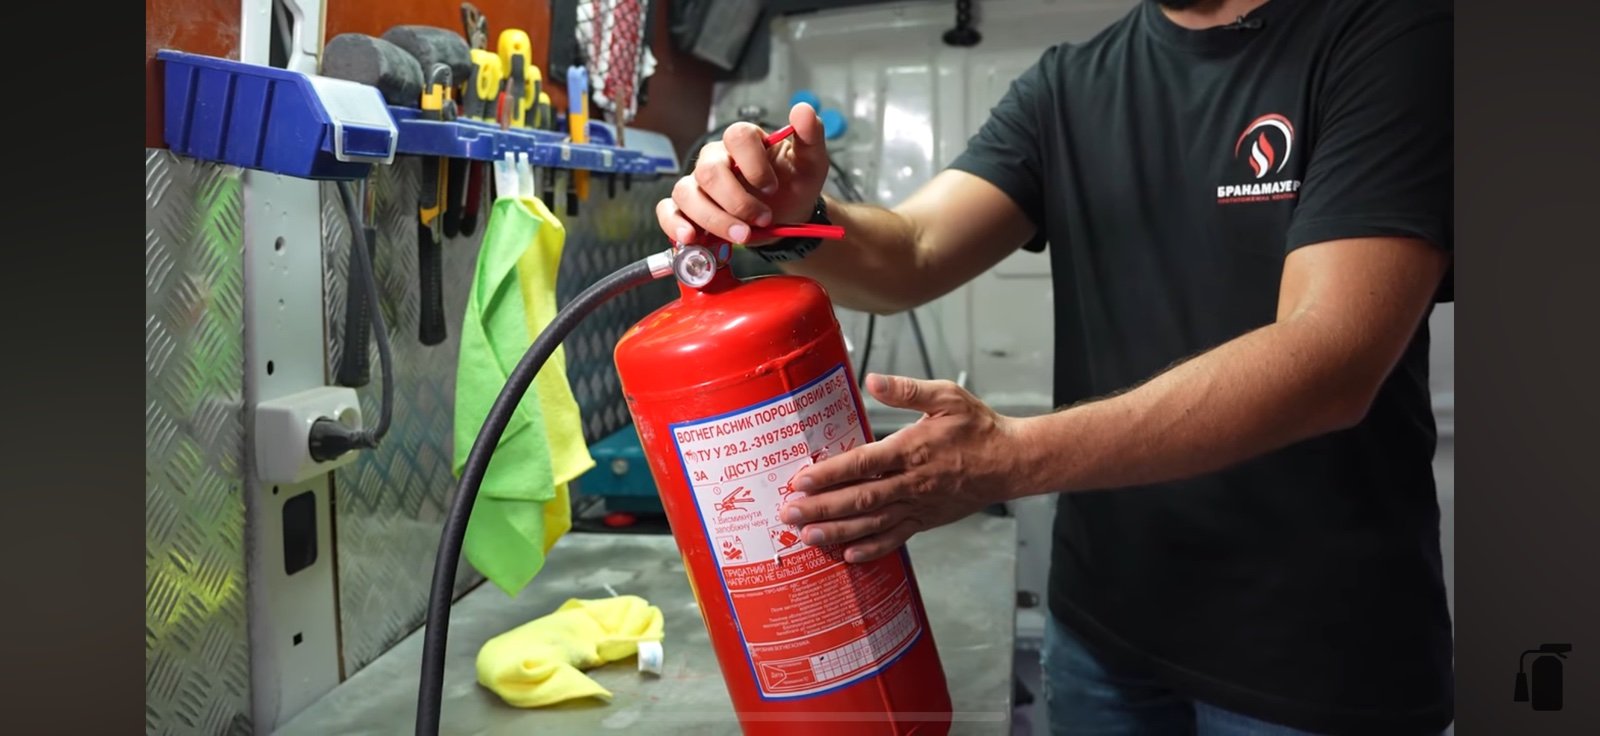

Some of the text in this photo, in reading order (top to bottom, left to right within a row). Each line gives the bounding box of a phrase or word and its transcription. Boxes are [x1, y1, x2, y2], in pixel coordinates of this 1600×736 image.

[1217, 180, 1301, 197] БРАНДМАУЕР
[677, 417, 754, 444] ВОГНЕГАСНИК
[755, 386, 825, 425] ПОРОШКОВИЙ
[697, 449, 712, 462] ТУ
[714, 446, 723, 459] У
[762, 441, 810, 467] 3675-98)
[724, 564, 767, 578] ПРИДАТНИЙ
[782, 550, 814, 568] ГАСІННЯ
[727, 574, 764, 587] НАПРУГОЮ
[764, 571, 775, 582] НЕ
[775, 563, 805, 579] БІЛЬШЕ
